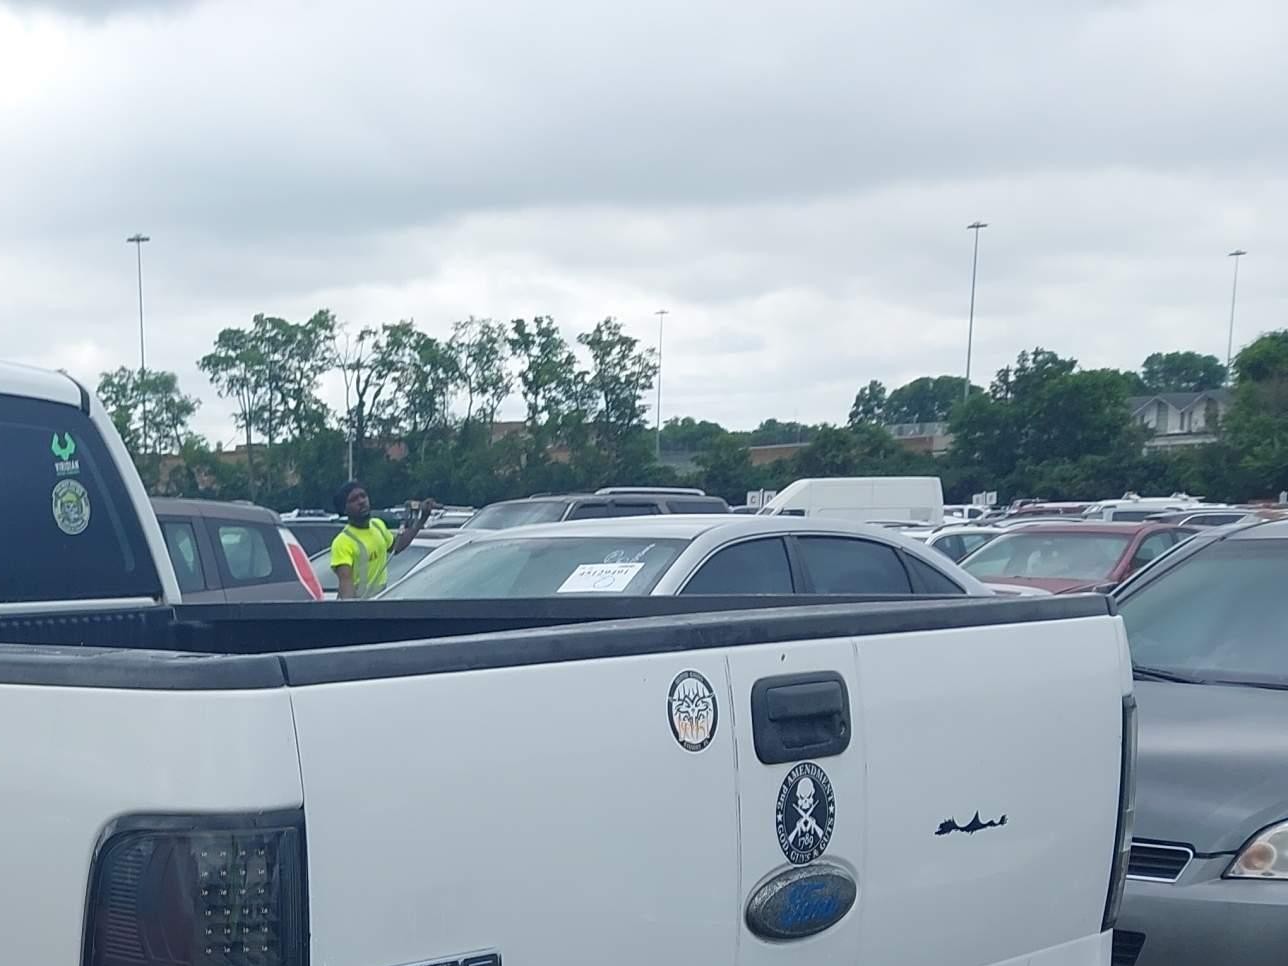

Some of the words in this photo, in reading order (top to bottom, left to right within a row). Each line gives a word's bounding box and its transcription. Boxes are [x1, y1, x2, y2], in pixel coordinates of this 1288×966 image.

[778, 784, 789, 811] 2nd
[787, 763, 834, 801] AMENDMENT
[798, 832, 814, 850] 1789
[819, 817, 834, 851] GUTS
